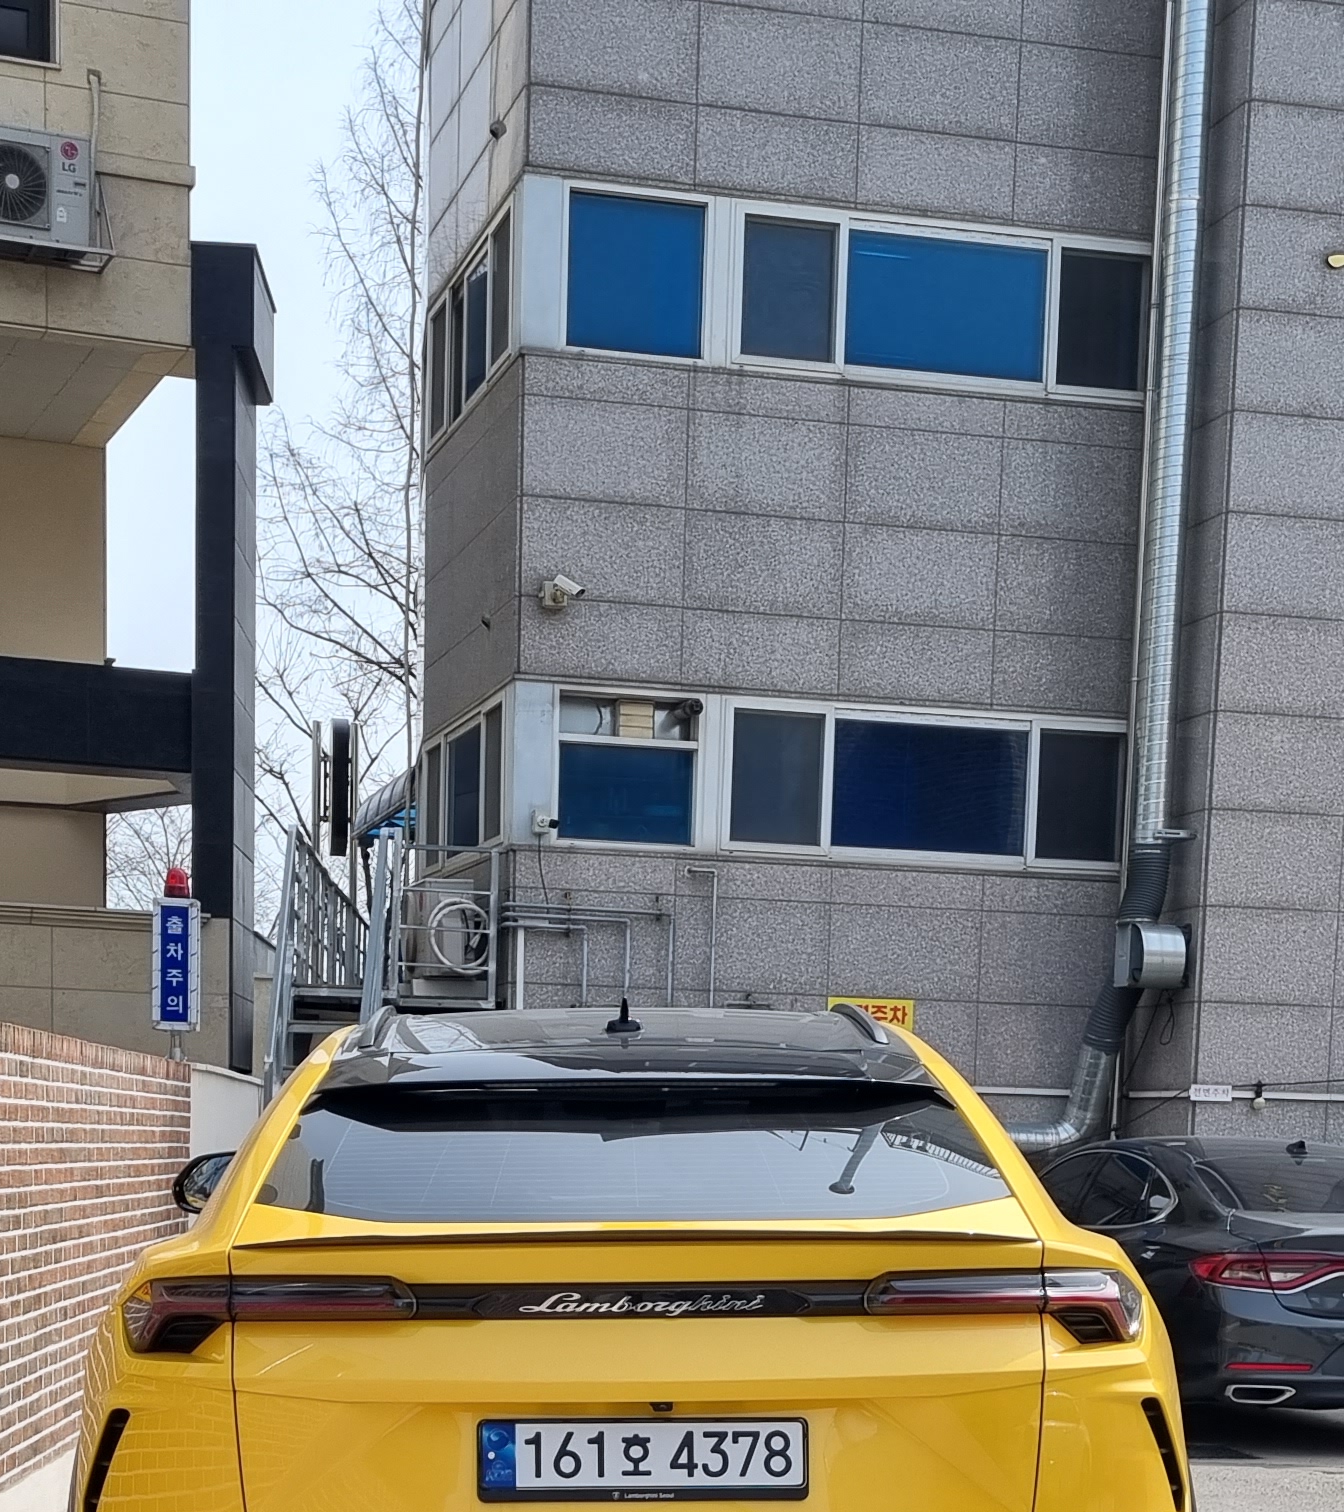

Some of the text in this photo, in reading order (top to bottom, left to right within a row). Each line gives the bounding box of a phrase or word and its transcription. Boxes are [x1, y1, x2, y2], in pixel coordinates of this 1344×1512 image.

[61, 162, 77, 174] LG
[165, 915, 184, 1014] 출차주의
[855, 1004, 908, 1025] 주차
[518, 1291, 766, 1317] Lamborghini
[523, 1429, 793, 1479] 161호 4378
